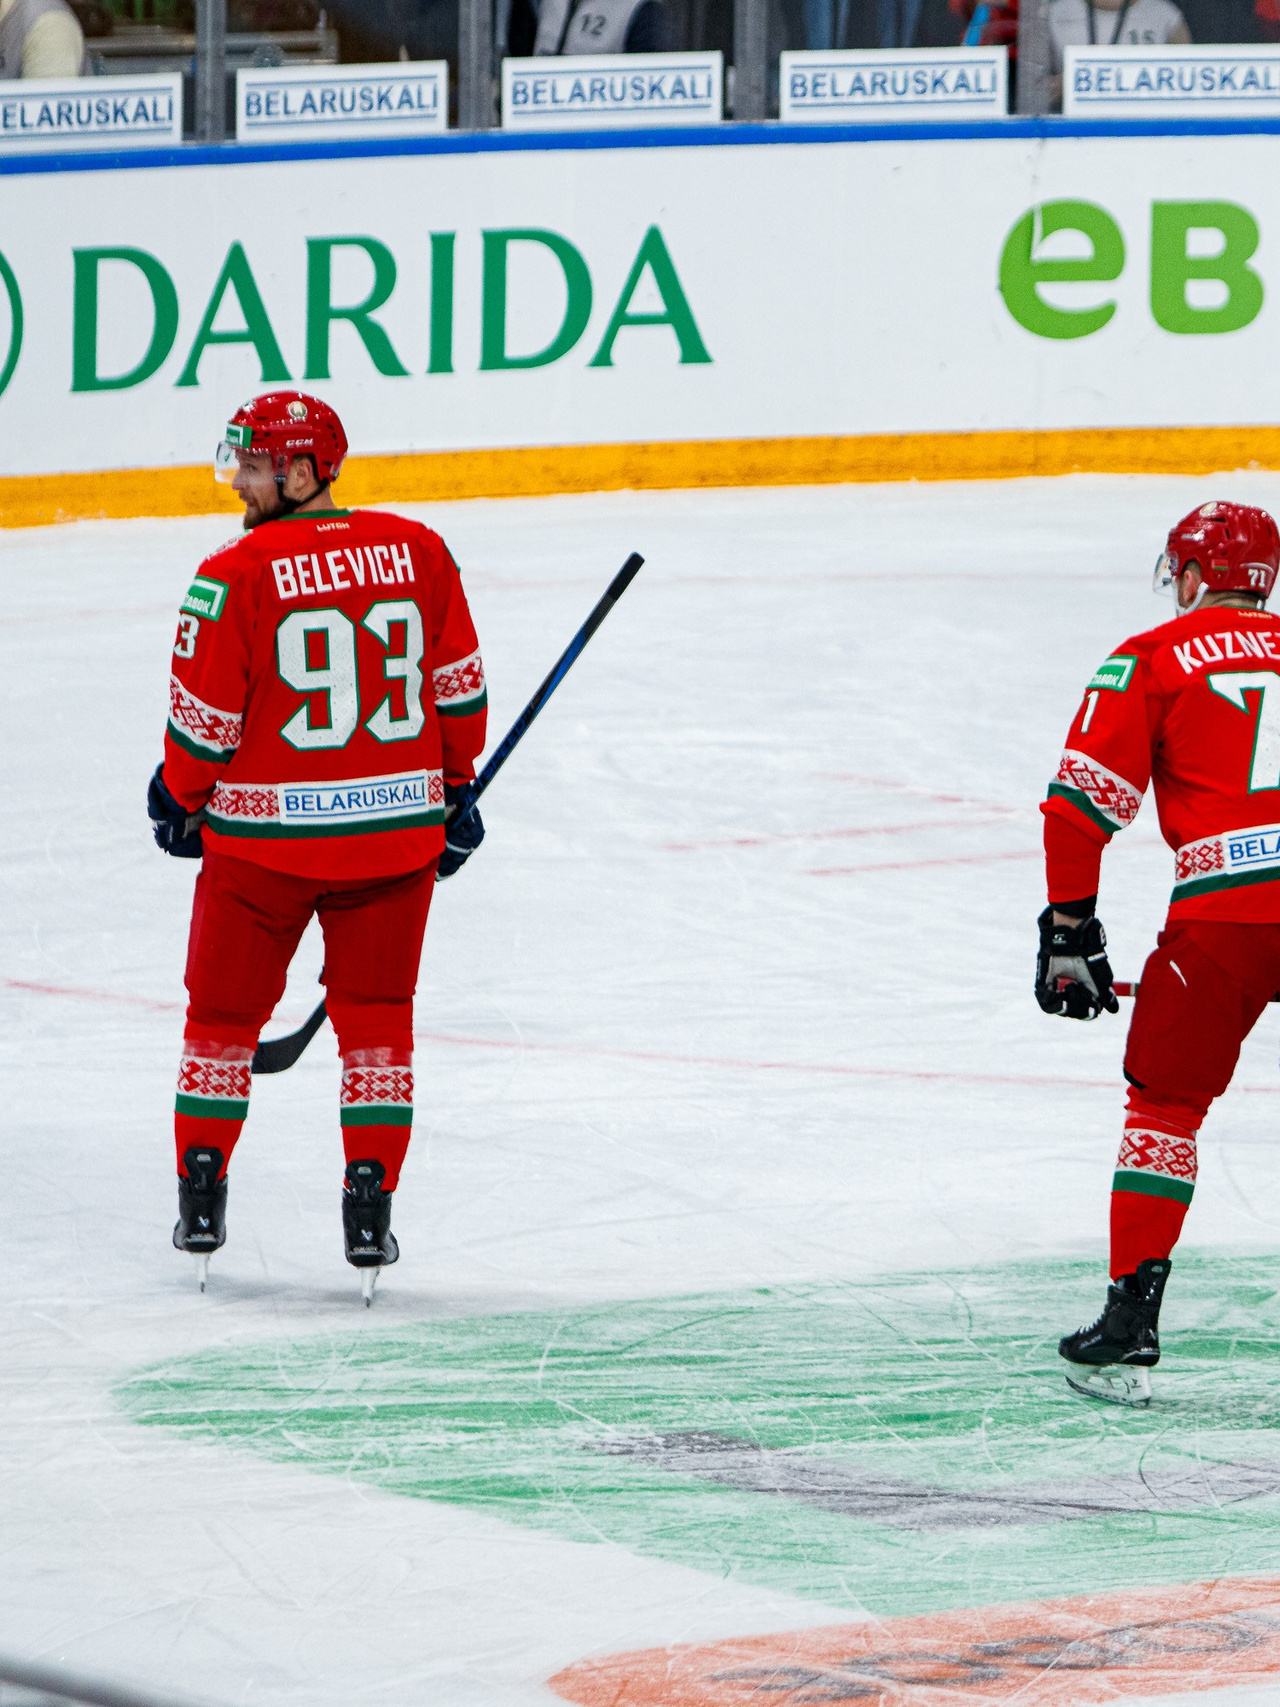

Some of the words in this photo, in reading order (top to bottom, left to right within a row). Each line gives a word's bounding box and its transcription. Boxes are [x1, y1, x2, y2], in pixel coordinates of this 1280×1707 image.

[243, 82, 439, 118] BELARUSKALI
[511, 74, 713, 106] BELARUSKALI
[789, 65, 998, 100] BELARUSKALI
[1, 93, 174, 130] ELARUSKALI
[71, 223, 714, 393] DARIDA
[286, 438, 314, 447] CCM
[271, 542, 416, 601] BELEVICH
[1248, 567, 1267, 588] 71
[275, 598, 426, 752] 93
[285, 781, 426, 812] BELARUSKALI
